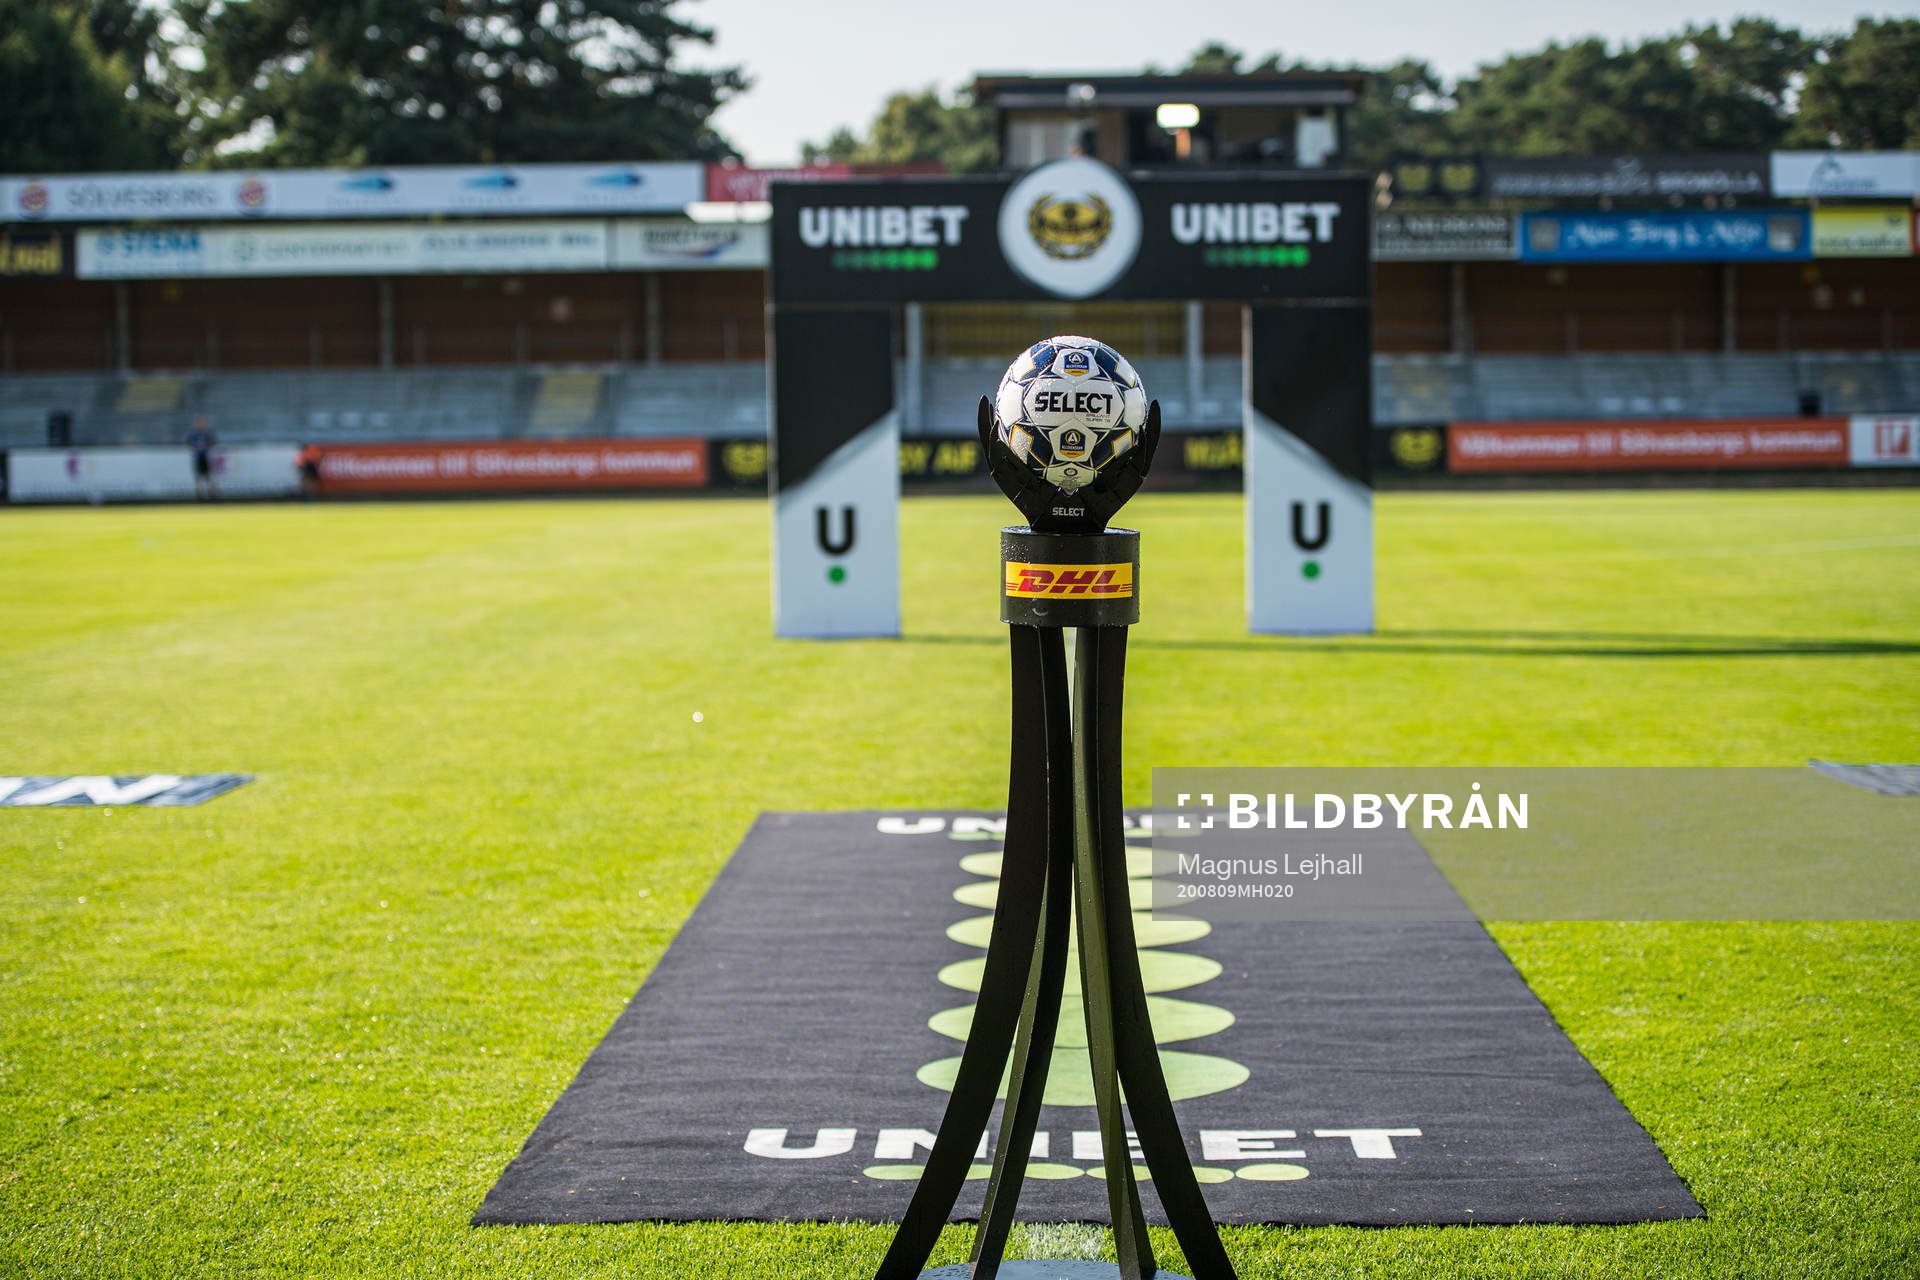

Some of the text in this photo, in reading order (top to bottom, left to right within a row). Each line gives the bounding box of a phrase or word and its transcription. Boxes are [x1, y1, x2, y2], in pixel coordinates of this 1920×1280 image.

[799, 206, 968, 248] UNIBET
[1171, 202, 1340, 244] UNIBET
[1034, 391, 1114, 415] SELECT
[817, 506, 855, 557] U
[1052, 506, 1085, 517] SELECT
[1291, 501, 1331, 552] U
[1018, 569, 1122, 593] DHL
